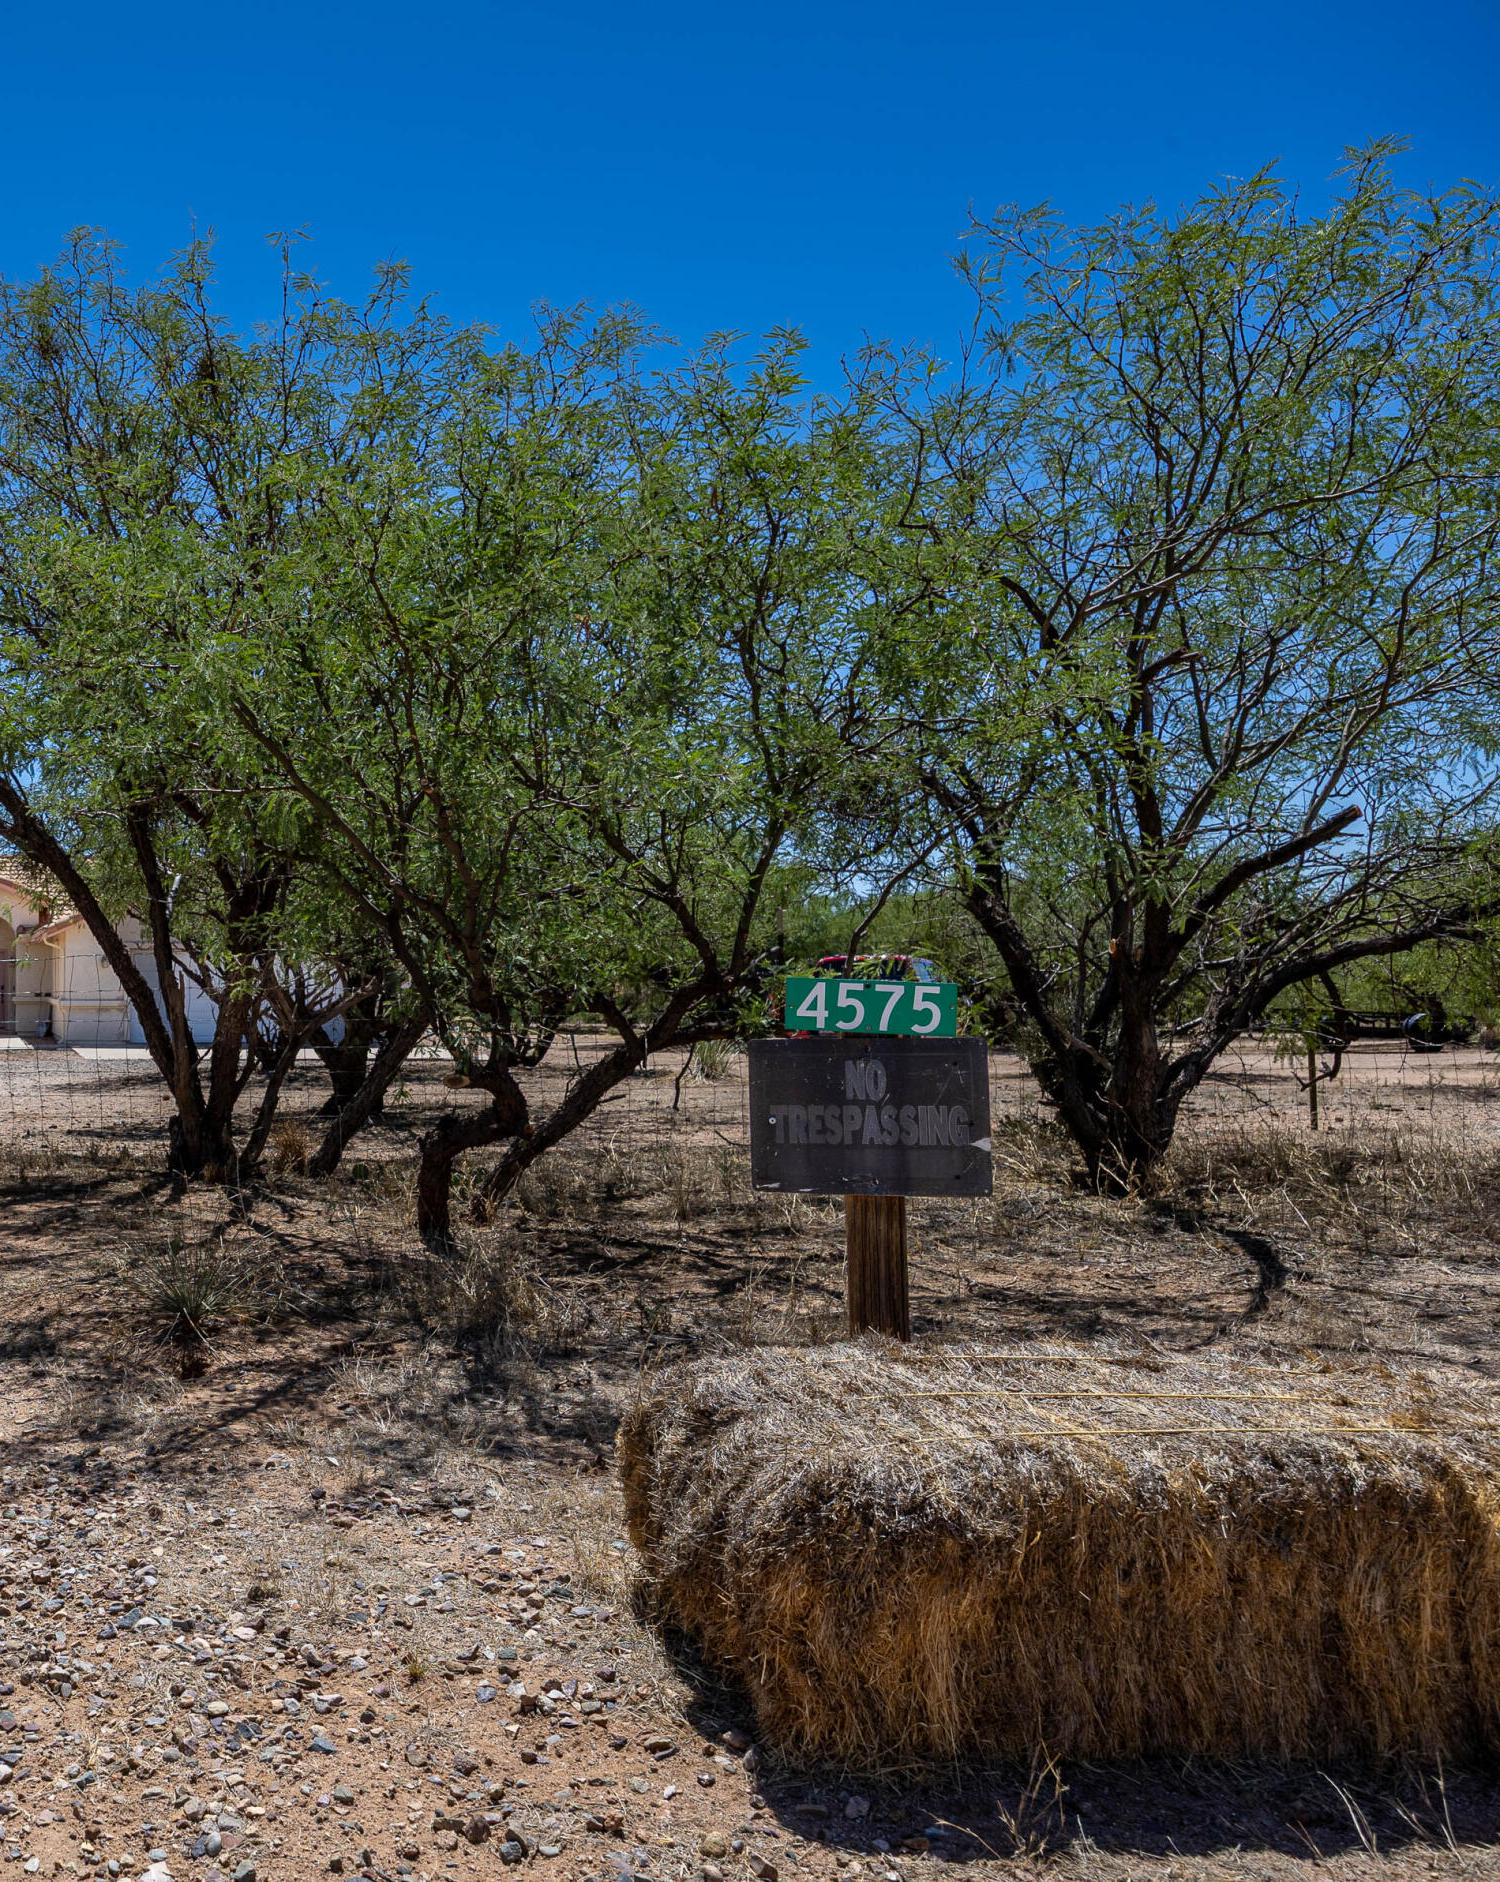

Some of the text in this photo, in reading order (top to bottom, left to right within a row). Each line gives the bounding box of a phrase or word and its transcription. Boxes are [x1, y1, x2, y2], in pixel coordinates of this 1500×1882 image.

[796, 982, 942, 1034] 4575
[845, 1059, 887, 1101] NO
[769, 1104, 970, 1146] TRESPASSING
